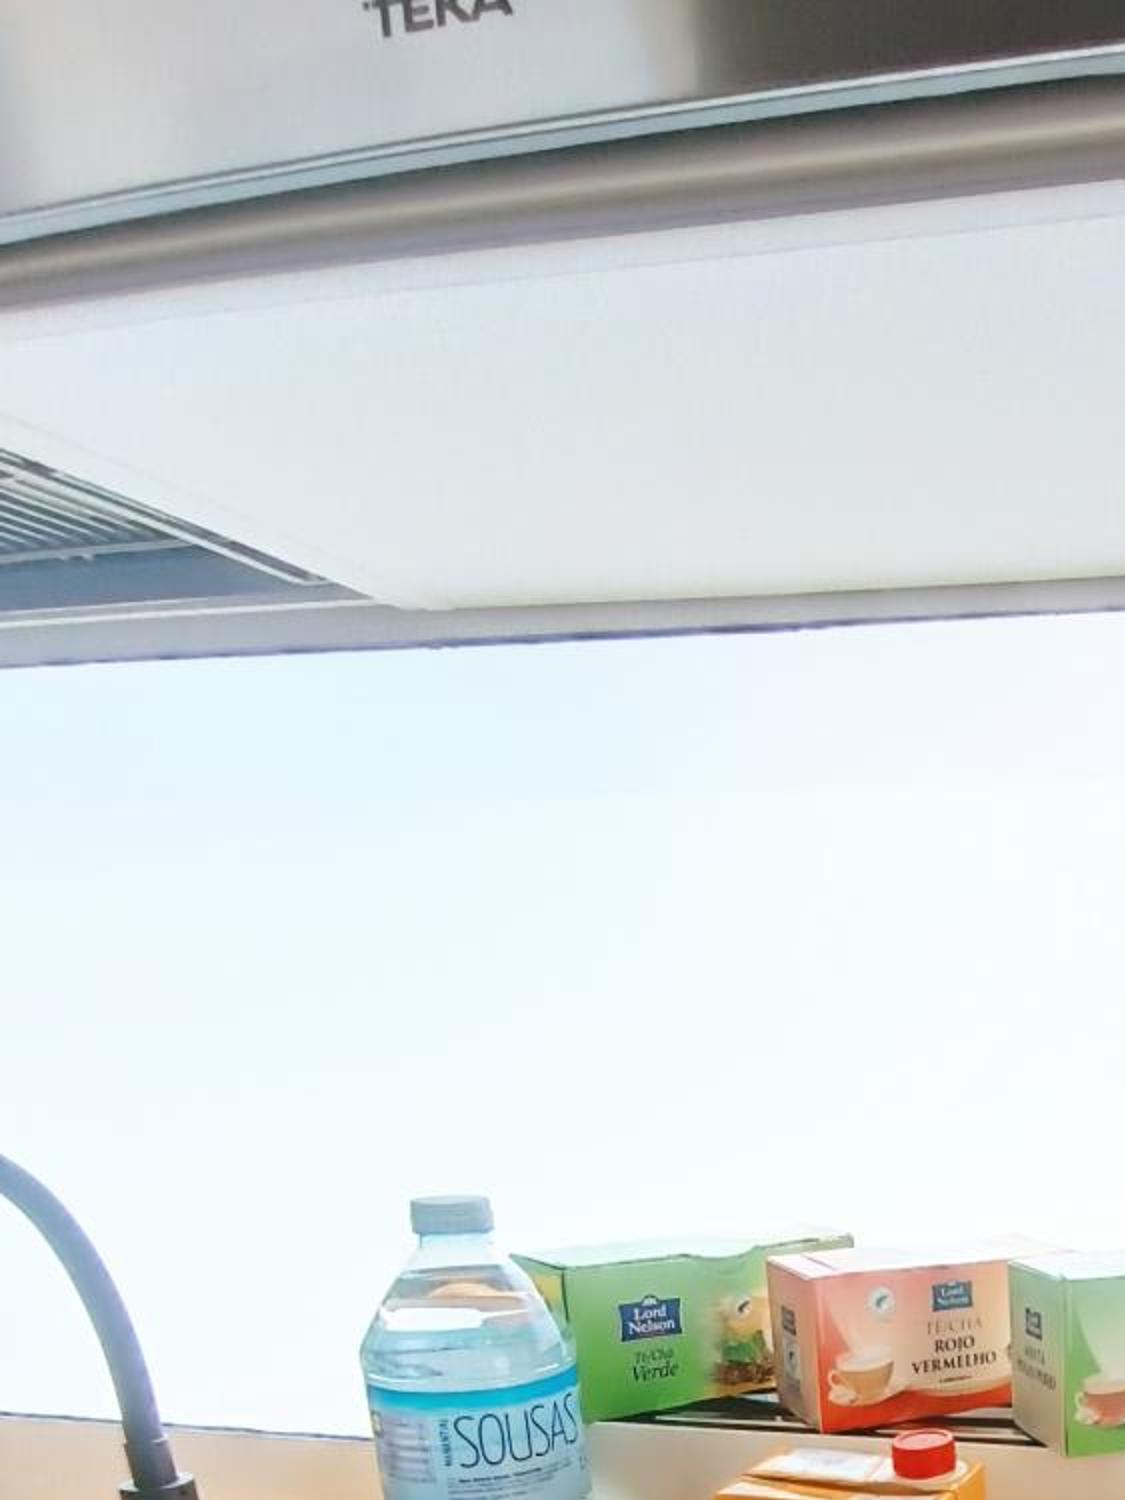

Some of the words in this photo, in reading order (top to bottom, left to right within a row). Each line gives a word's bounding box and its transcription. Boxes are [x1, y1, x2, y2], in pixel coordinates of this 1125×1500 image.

[372, 0, 514, 38] TEKA
[632, 1303, 667, 1321] Lord
[627, 1319, 676, 1335] Nelson
[934, 1335, 975, 1353] ROJO
[632, 1359, 679, 1383] Verde
[911, 1350, 997, 1375] VERMELHO
[453, 1392, 578, 1469] SOUSAS
